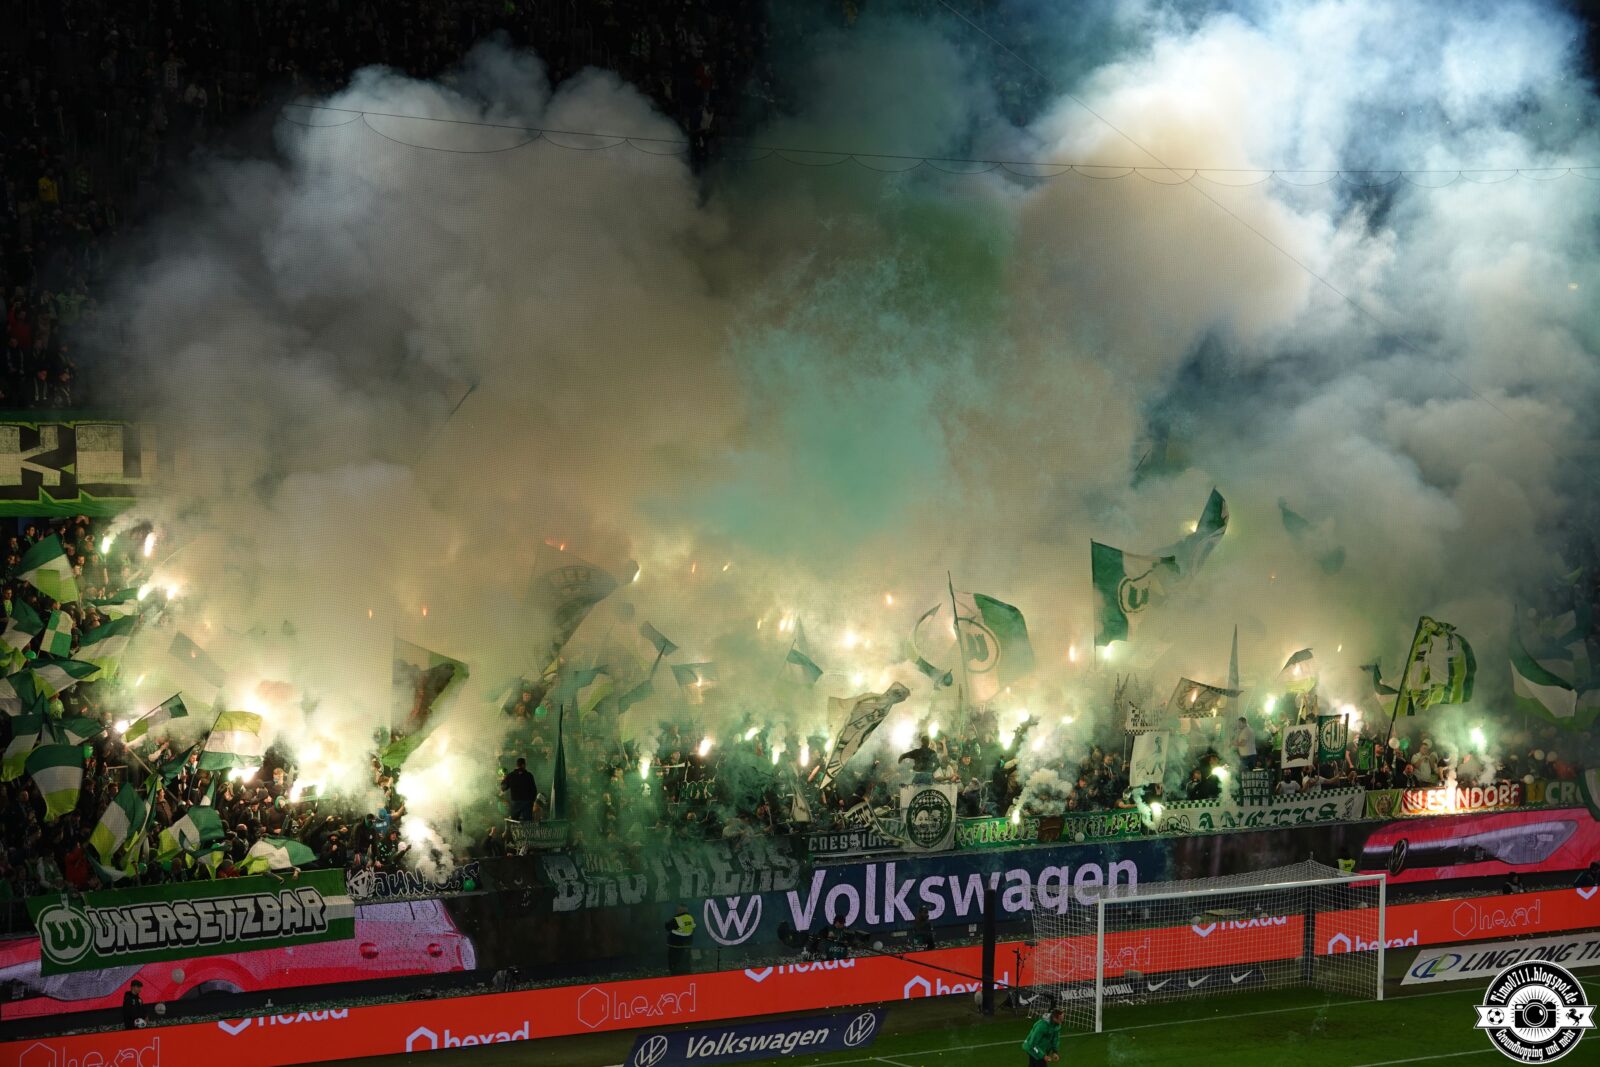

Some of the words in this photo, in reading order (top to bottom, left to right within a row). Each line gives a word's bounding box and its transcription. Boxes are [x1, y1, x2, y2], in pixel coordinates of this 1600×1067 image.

[1402, 783, 1519, 811] WESNDORF
[786, 858, 1138, 931] Volkswagen
[87, 888, 327, 955] UNERSETZBAR
[1458, 942, 1579, 972] LINGLONG
[936, 971, 1009, 996] hexd
[1060, 984, 1134, 1001] NIKE.COMOOTBALL
[685, 1027, 829, 1058] Volkswagen
